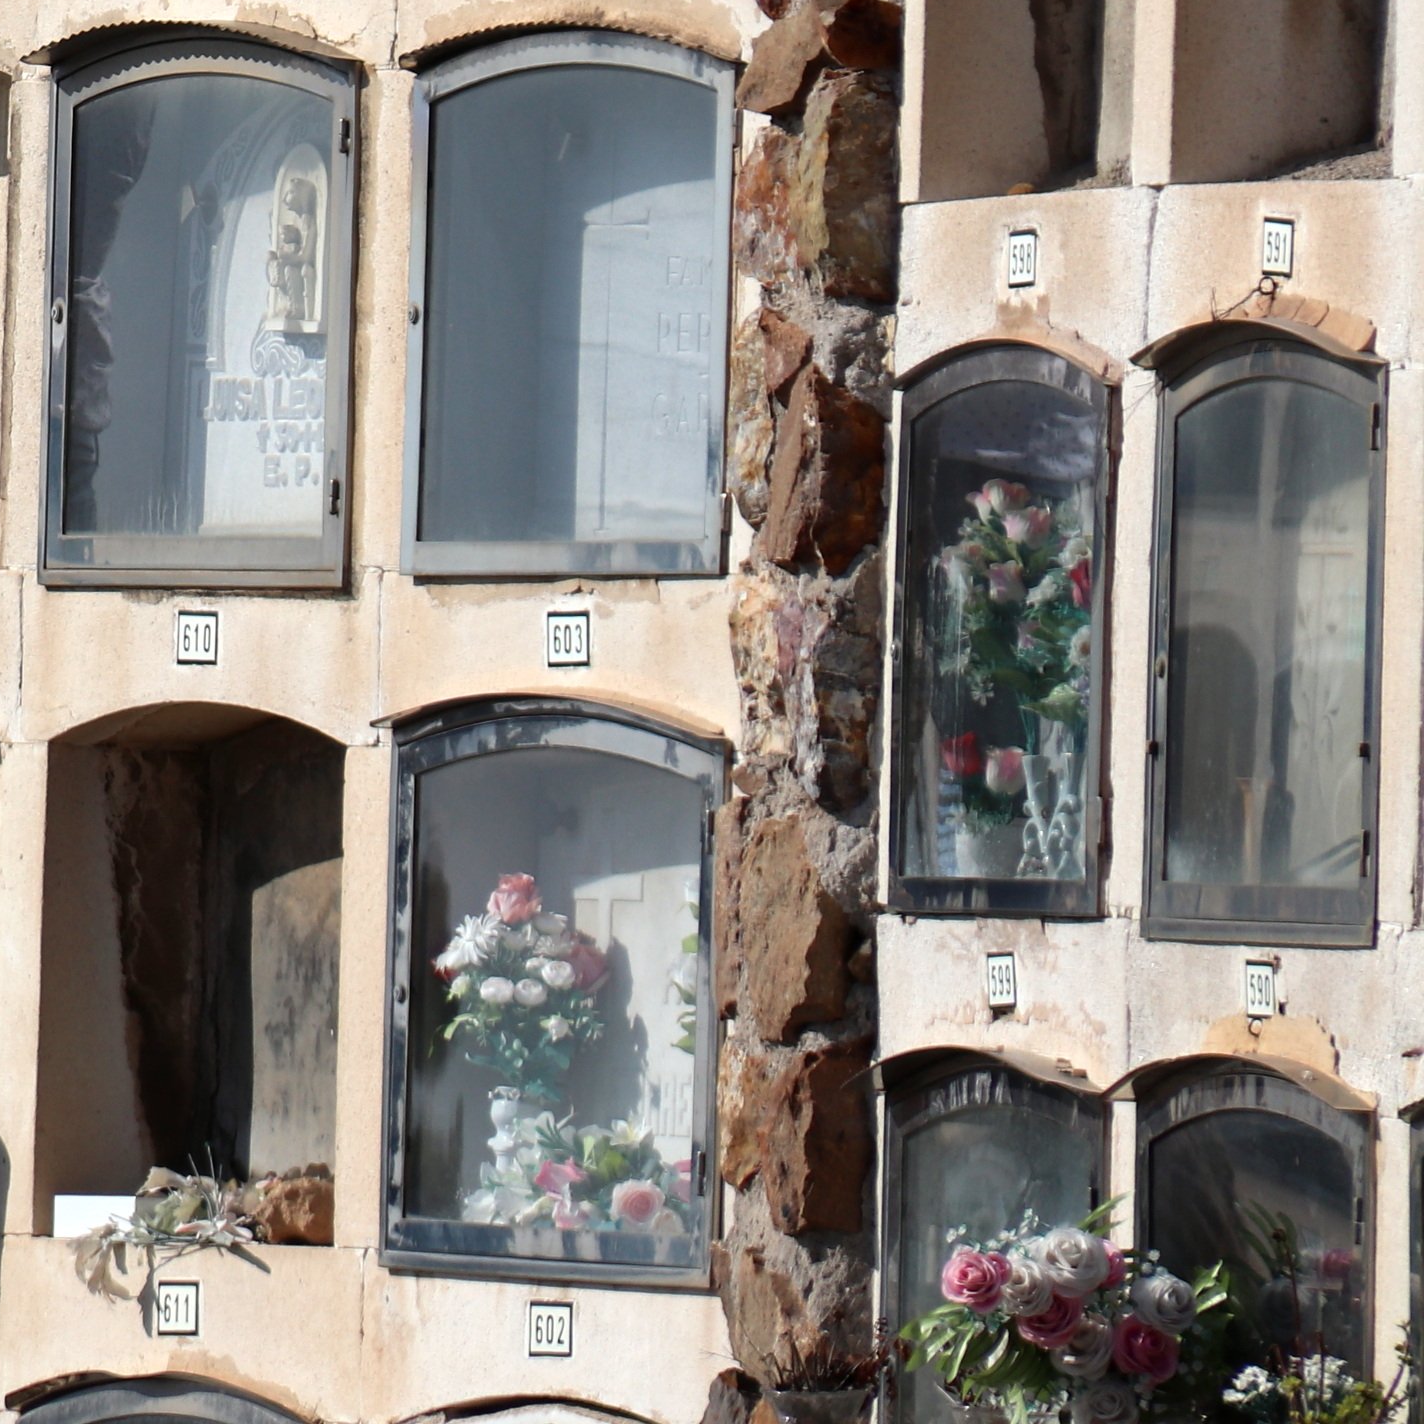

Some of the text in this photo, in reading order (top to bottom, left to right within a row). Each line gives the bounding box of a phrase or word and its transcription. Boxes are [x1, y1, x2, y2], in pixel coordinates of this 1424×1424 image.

[1012, 242, 1033, 276] 598
[1266, 231, 1288, 265] 591
[183, 623, 211, 653] 610
[553, 623, 583, 654] 603
[991, 965, 1011, 998] 599
[1249, 973, 1271, 1007] 590
[163, 1293, 190, 1324] 611
[535, 1314, 565, 1345] 602
